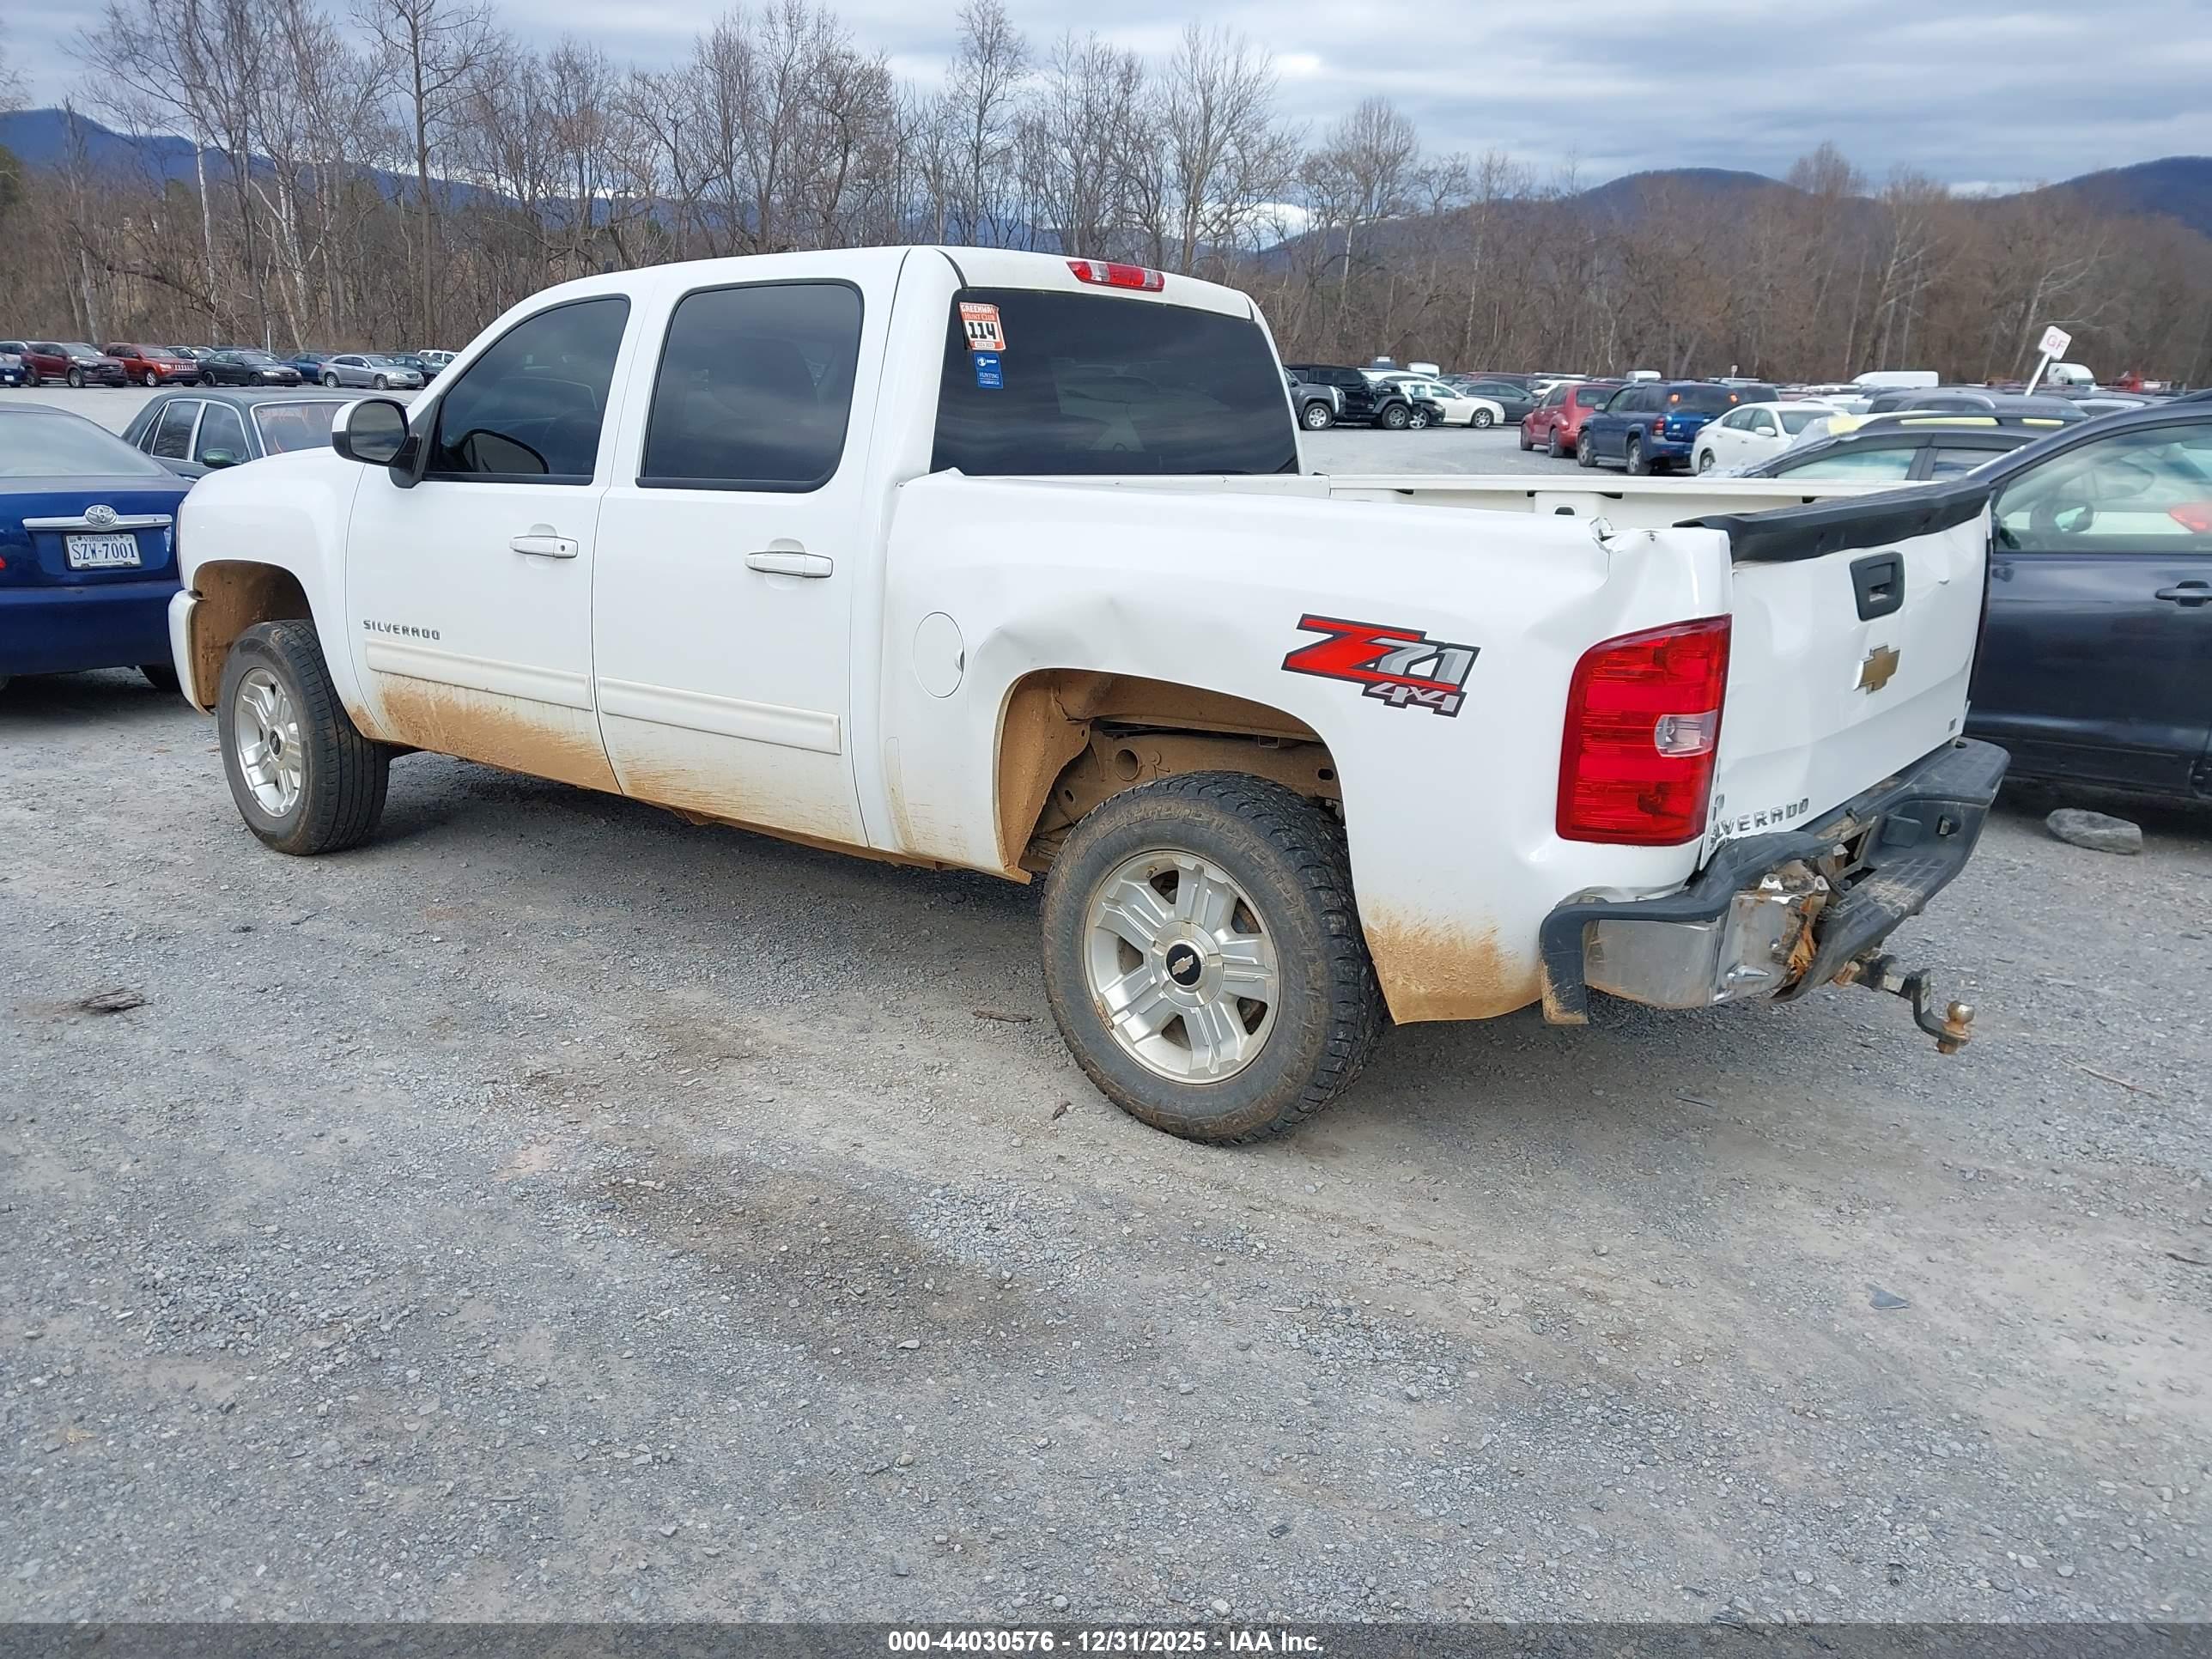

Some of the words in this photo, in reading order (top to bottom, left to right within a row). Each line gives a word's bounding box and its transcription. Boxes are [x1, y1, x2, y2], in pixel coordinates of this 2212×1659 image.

[71, 542, 137, 561] SZW-7001
[362, 619, 441, 641] SILVERADO
[1283, 615, 1479, 692] Z71
